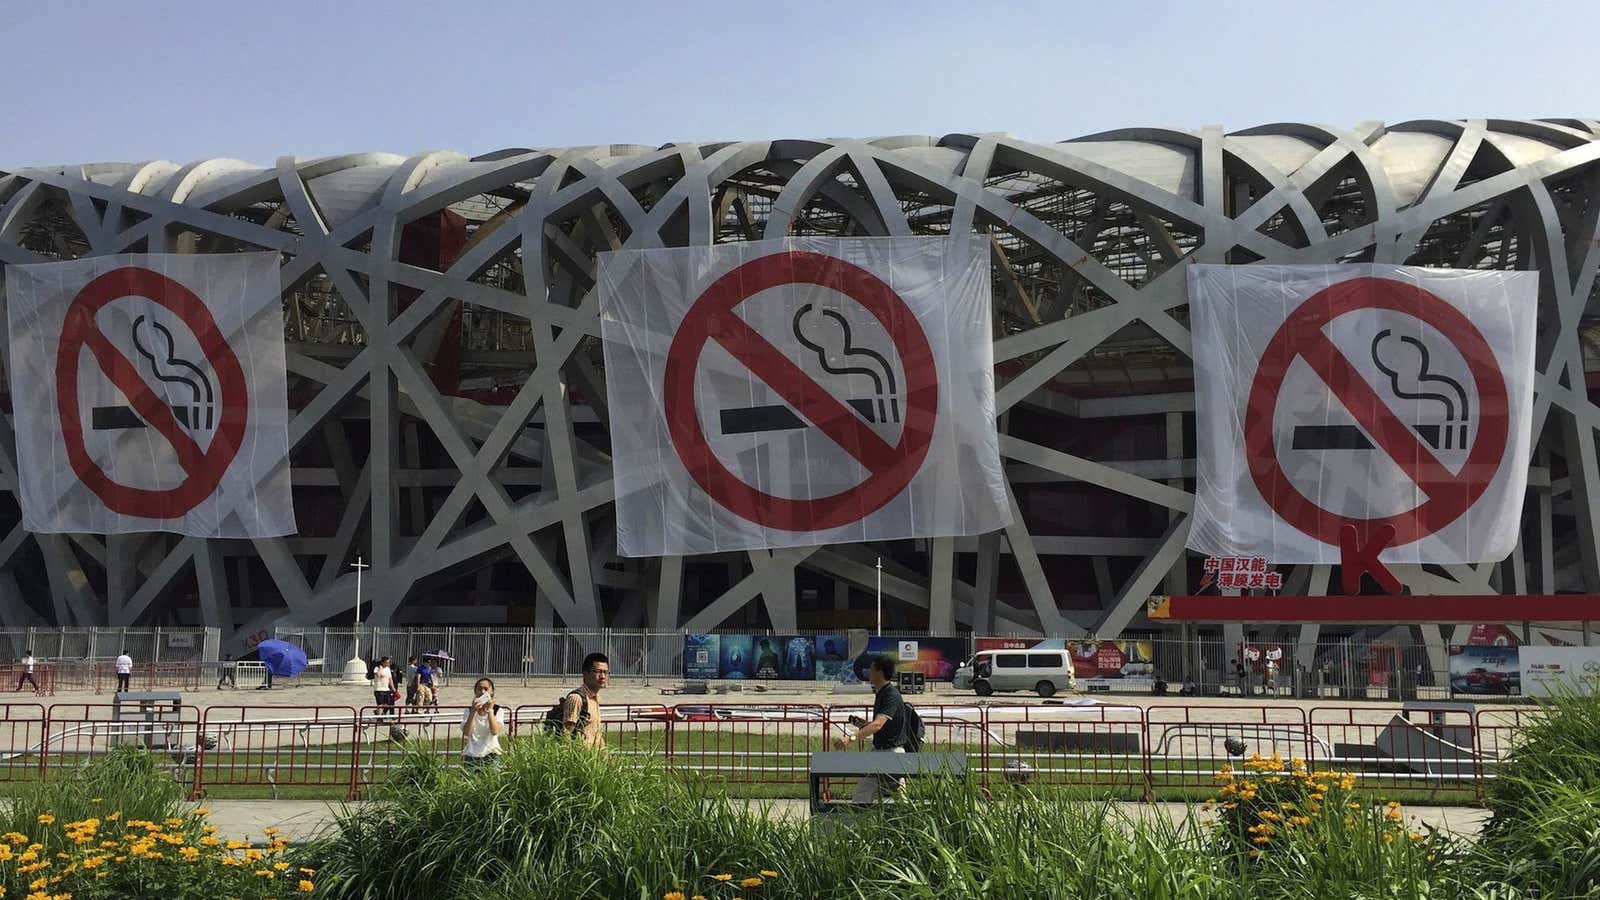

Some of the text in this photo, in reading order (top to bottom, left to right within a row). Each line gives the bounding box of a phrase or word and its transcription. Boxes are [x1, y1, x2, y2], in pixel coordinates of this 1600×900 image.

[1204, 555, 1267, 573] 中国汉能
[1217, 571, 1282, 590] 薄膜发电
